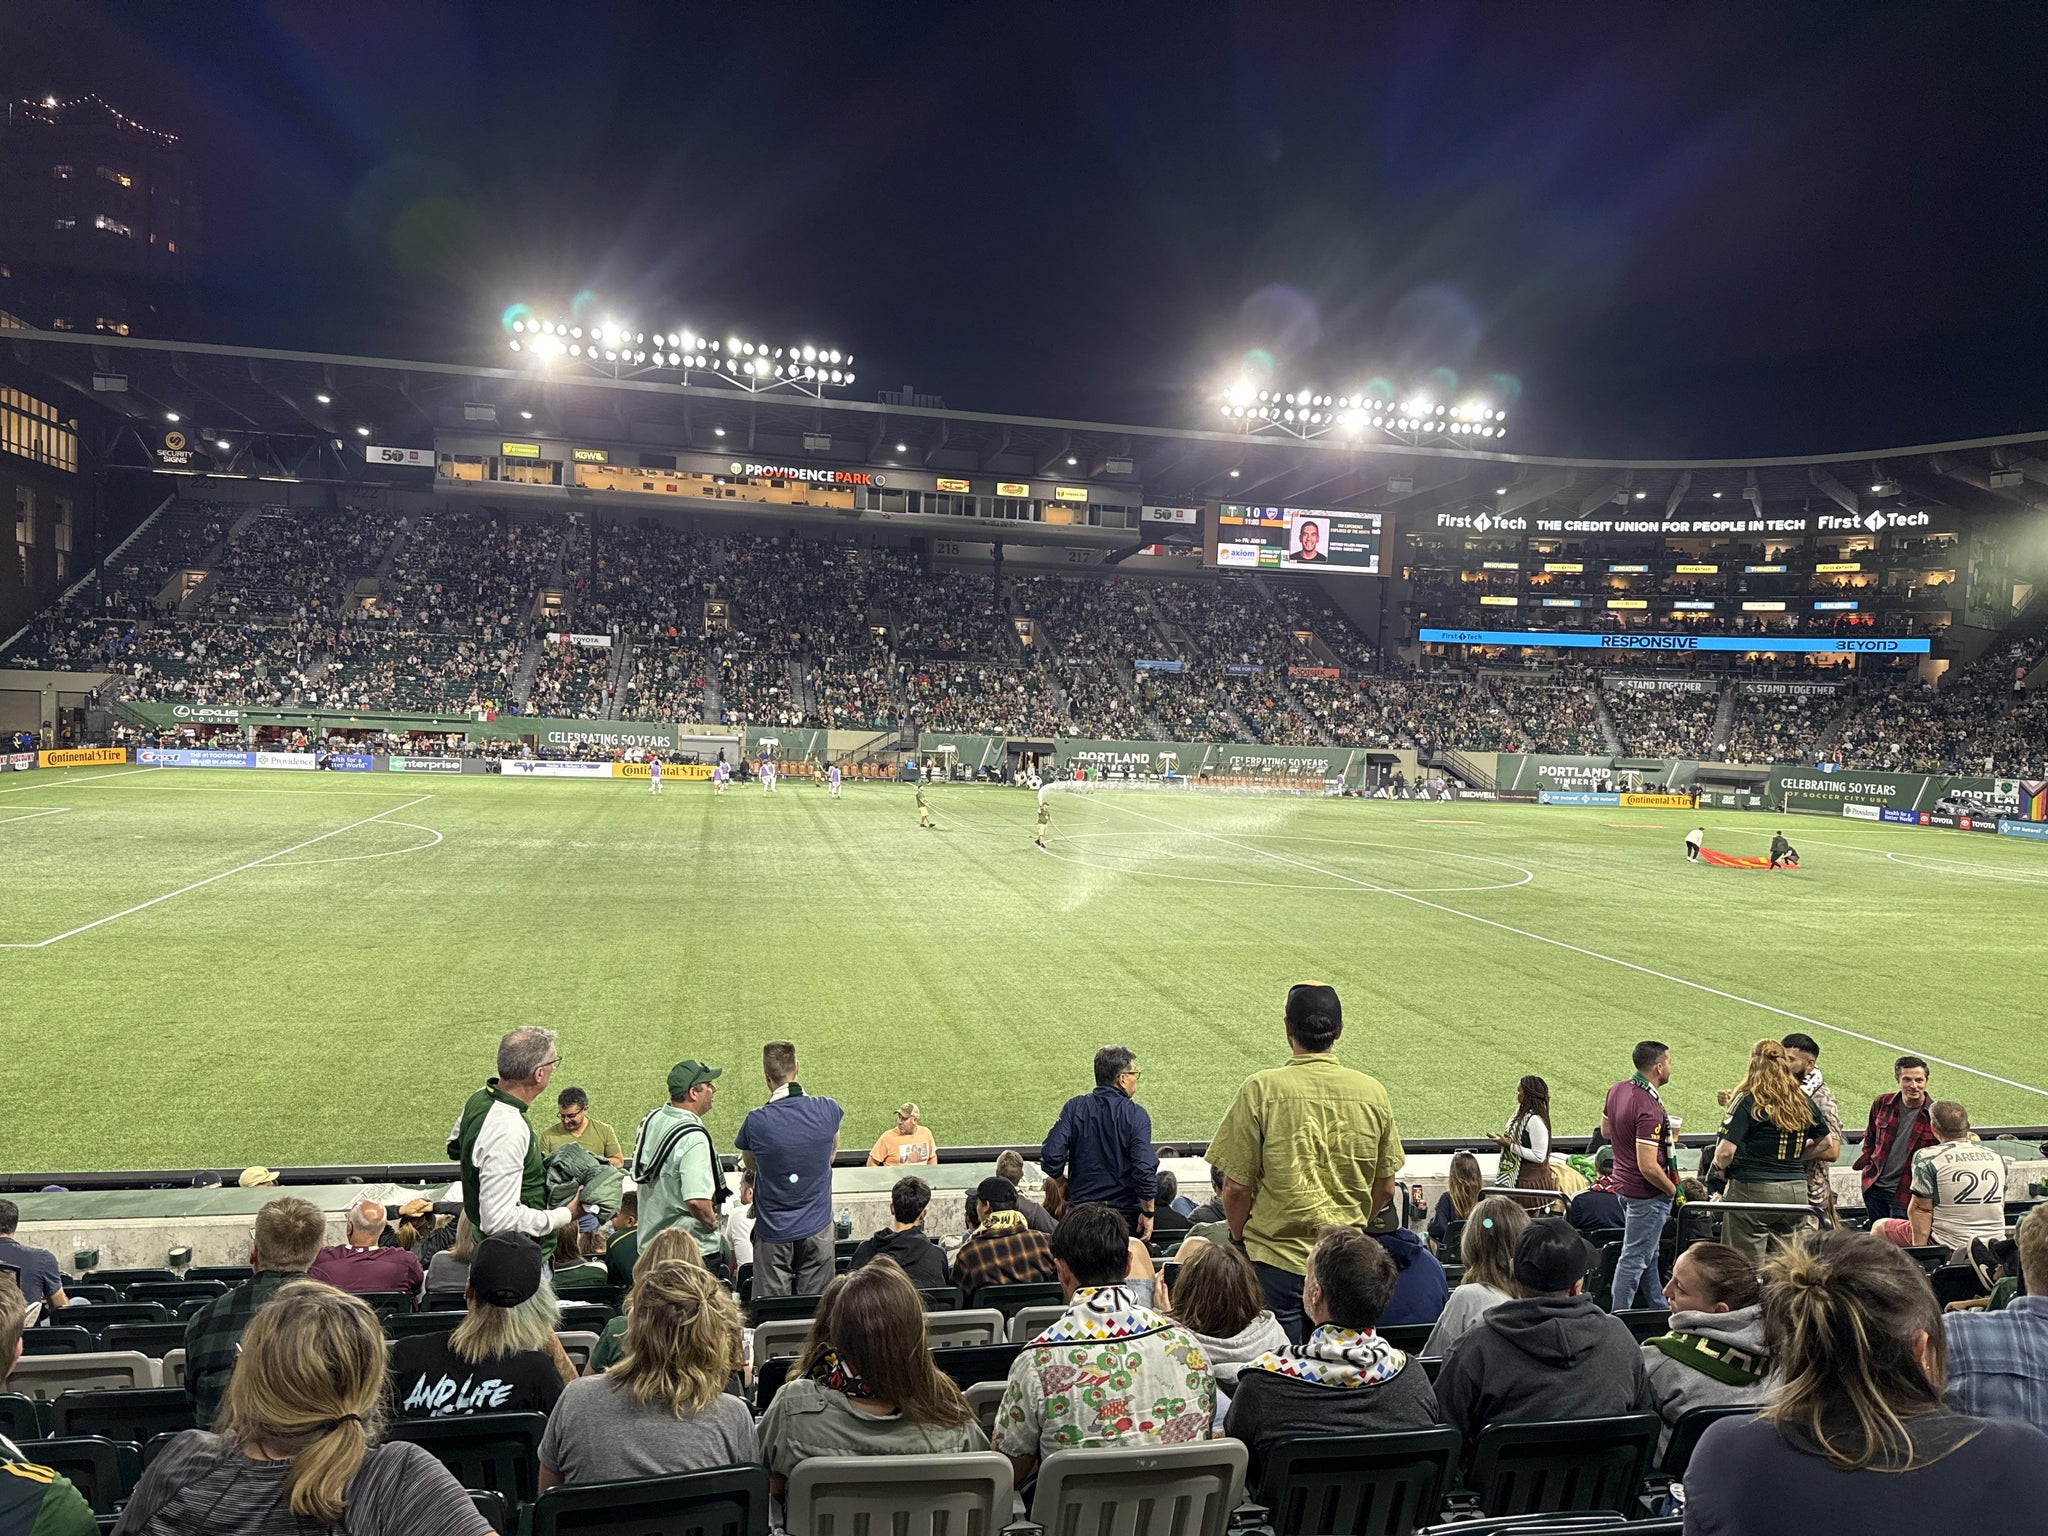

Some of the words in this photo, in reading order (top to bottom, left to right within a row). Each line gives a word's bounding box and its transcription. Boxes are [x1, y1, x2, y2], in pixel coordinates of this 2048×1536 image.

[157, 449, 194, 458] SECURITY
[163, 455, 188, 464] SIGNS
[1245, 506, 1251, 517] 1
[1253, 507, 1260, 518] 0
[1437, 513, 1472, 529] First
[1492, 515, 1527, 530] Tech
[1536, 519, 1562, 531] THE
[1564, 520, 1612, 532] CREDIT
[1614, 520, 1659, 532] UNION
[1661, 521, 1690, 532] FOR
[1692, 520, 1746, 532] PEOPLE
[1748, 520, 1764, 531] IN
[1767, 519, 1806, 531] TECH
[1818, 513, 1861, 530] First
[1887, 511, 1929, 527] Tech
[937, 543, 960, 555] 218
[1230, 549, 1255, 557] axiom
[1069, 551, 1090, 563] 217
[572, 636, 599, 644] TOYOTA
[1442, 632, 1458, 640] First
[1467, 633, 1483, 641] Tech
[1601, 635, 1698, 649] RESPONSIVE
[1835, 640, 1899, 651] BEYOND
[1628, 679, 1655, 690] STAND
[1657, 681, 1701, 692] TOGETHER
[1756, 684, 1786, 694] STAND
[1788, 685, 1835, 696] TOGETHER
[191, 708, 239, 717] LEXUS
[548, 731, 618, 746] CELEBRATING
[621, 734, 635, 746] 50
[637, 735, 671, 747] YEARS
[47, 751, 95, 766] Continental
[103, 750, 121, 761] Tire
[140, 751, 180, 763] Crest
[270, 756, 314, 767] Providence
[1078, 751, 1150, 764] PORTLAND
[394, 759, 460, 770] enterprise
[1289, 758, 1300, 768] 50
[1300, 759, 1329, 769] YEARS
[688, 766, 712, 777] Tire
[1538, 765, 1611, 779] PORTLAND
[1554, 777, 1594, 786] TIMBERS
[1781, 778, 1846, 792] CELEBRATING
[1848, 782, 1863, 793] 50
[1863, 783, 1896, 796] YEARS
[1462, 791, 1496, 799] BIDWELL
[1627, 795, 1670, 805] Continental
[1802, 792, 1840, 800] SOCCER
[1851, 807, 1878, 818] Providence
[1931, 816, 1954, 825] TOYOTA
[1971, 821, 1996, 830] TOYOTA
[1945, 1152, 1994, 1163] PAREDES
[1952, 1168, 2002, 1205] 22
[403, 1372, 457, 1411] AND
[455, 1373, 514, 1411] LIFE
